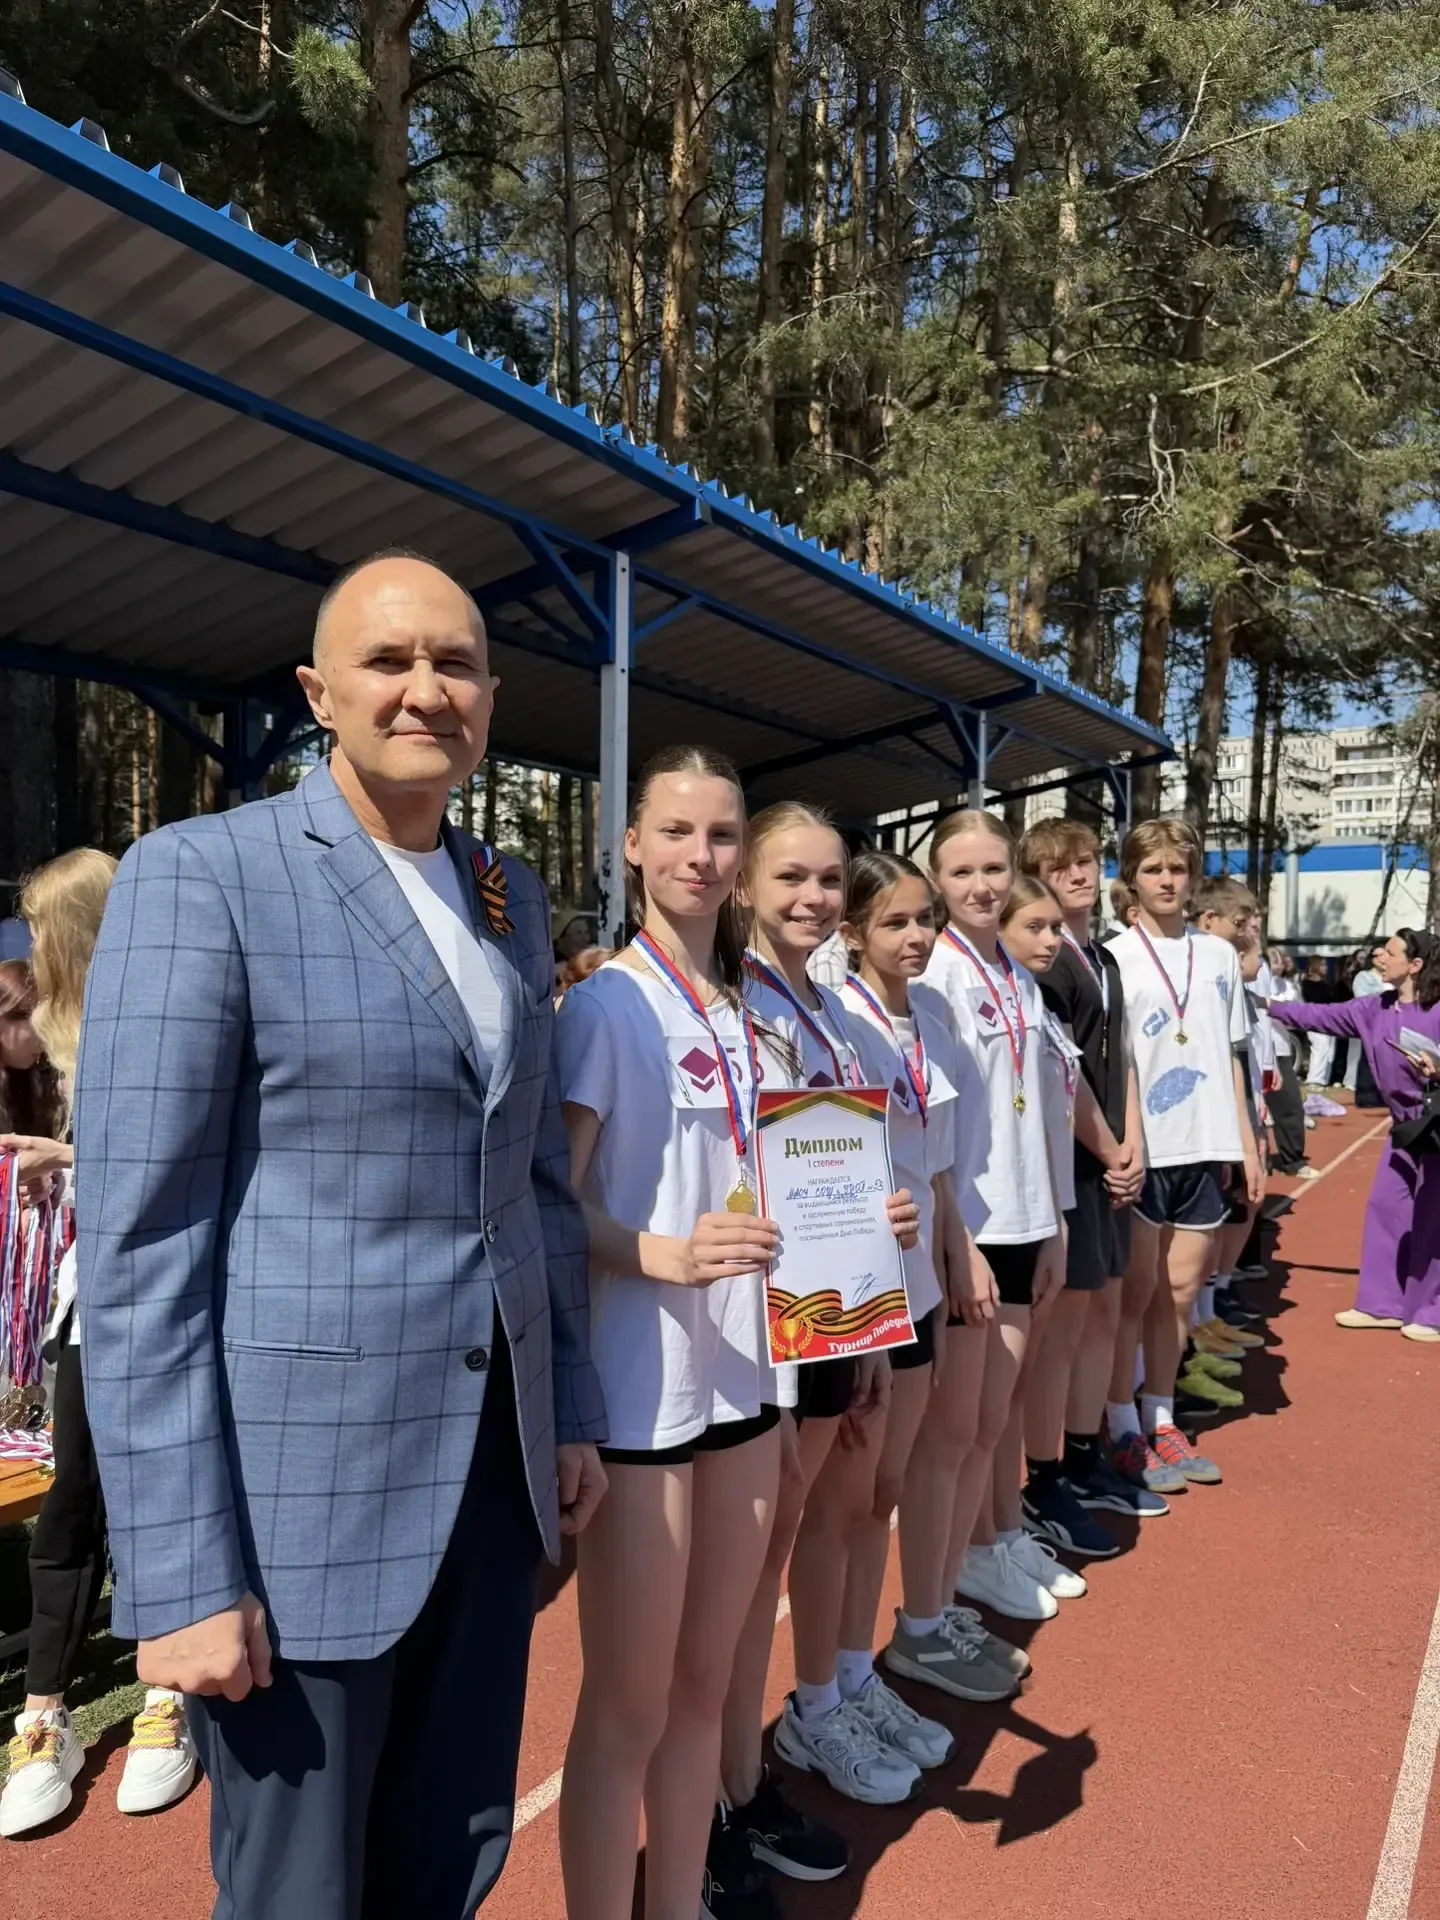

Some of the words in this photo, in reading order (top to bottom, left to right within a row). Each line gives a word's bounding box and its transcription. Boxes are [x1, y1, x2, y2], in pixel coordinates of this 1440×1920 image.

[784, 1137, 863, 1158] Диплом
[813, 1159, 845, 1168] степени
[808, 1175, 851, 1185] НАГРАЖДАЕТСЯ
[798, 1221, 833, 1232] спортивных
[828, 1334, 873, 1353] Турнир
